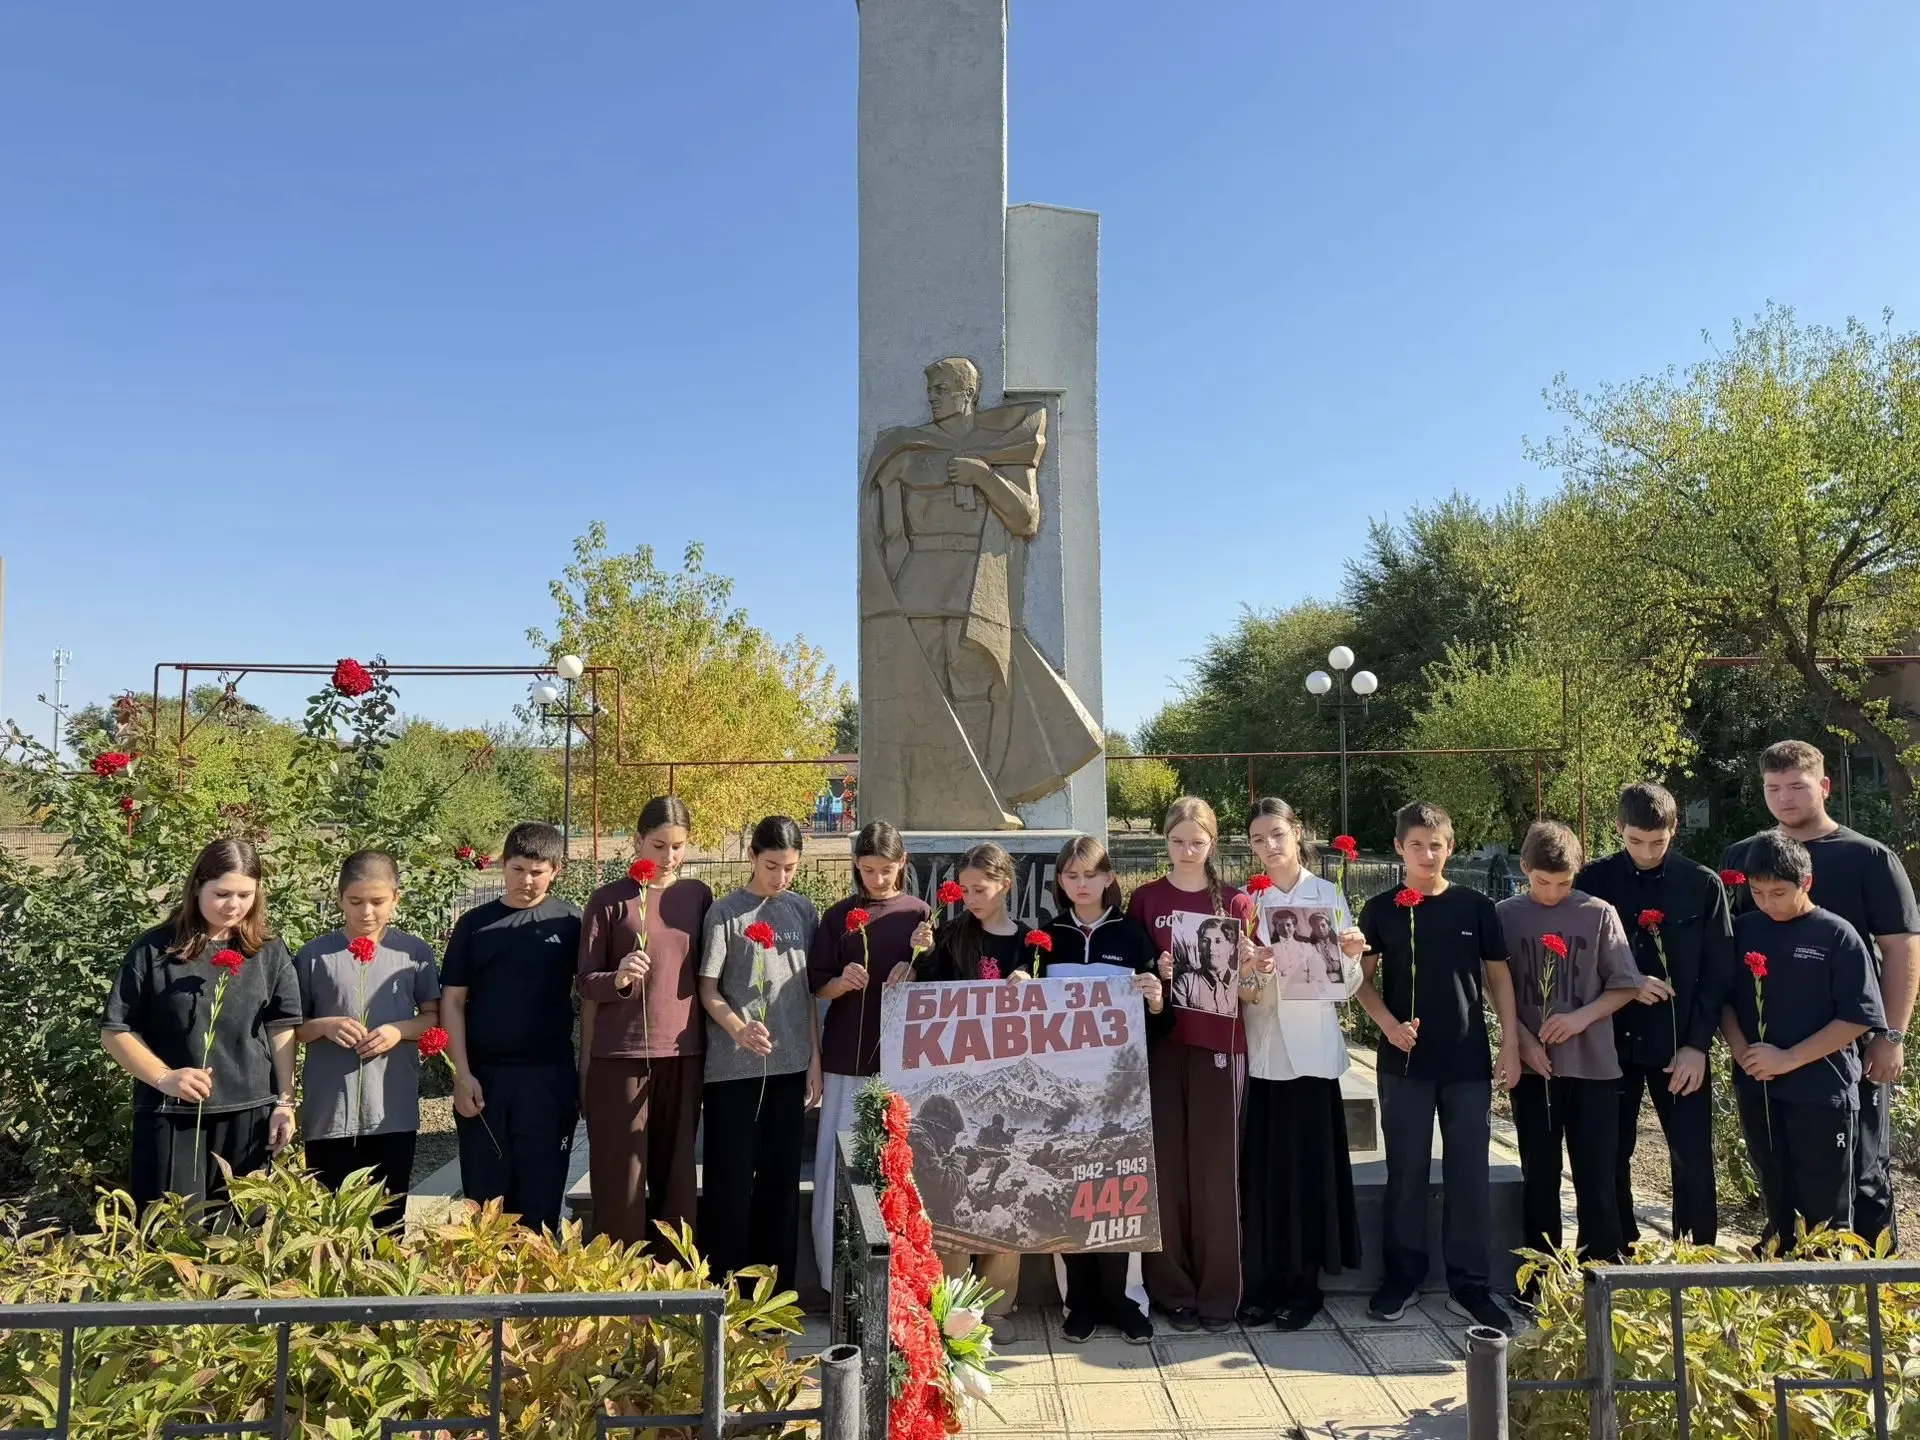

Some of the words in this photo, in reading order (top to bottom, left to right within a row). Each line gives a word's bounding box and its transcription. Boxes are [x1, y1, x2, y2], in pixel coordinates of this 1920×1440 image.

[905, 984, 1048, 1021] БИТВА
[1064, 981, 1113, 1008] ЗА
[902, 1009, 1129, 1070] КАВКАЗ
[1071, 1174, 1148, 1222] 442
[1085, 1215, 1142, 1245] ДНЯ
